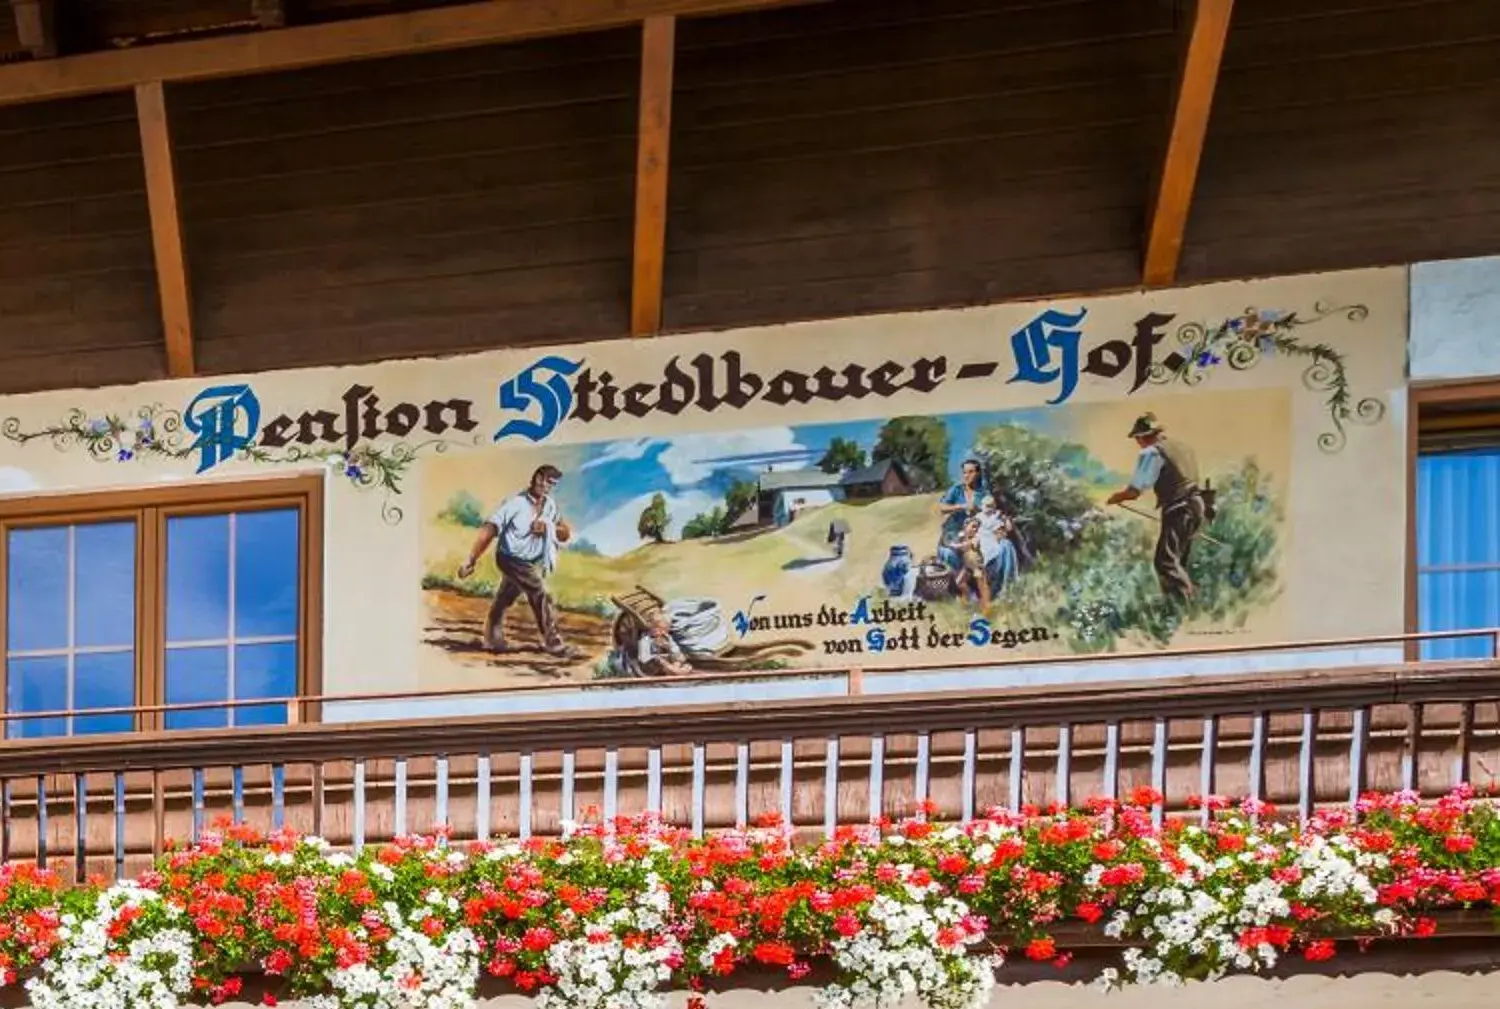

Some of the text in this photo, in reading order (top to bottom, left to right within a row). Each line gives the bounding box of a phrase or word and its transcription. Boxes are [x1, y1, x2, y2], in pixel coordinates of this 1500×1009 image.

[184, 383, 479, 474] Pension
[774, 611, 814, 629] uns
[816, 604, 849, 627] die
[849, 595, 935, 624] Arbeit,
[822, 617, 1060, 655] von Gott der Segen.
